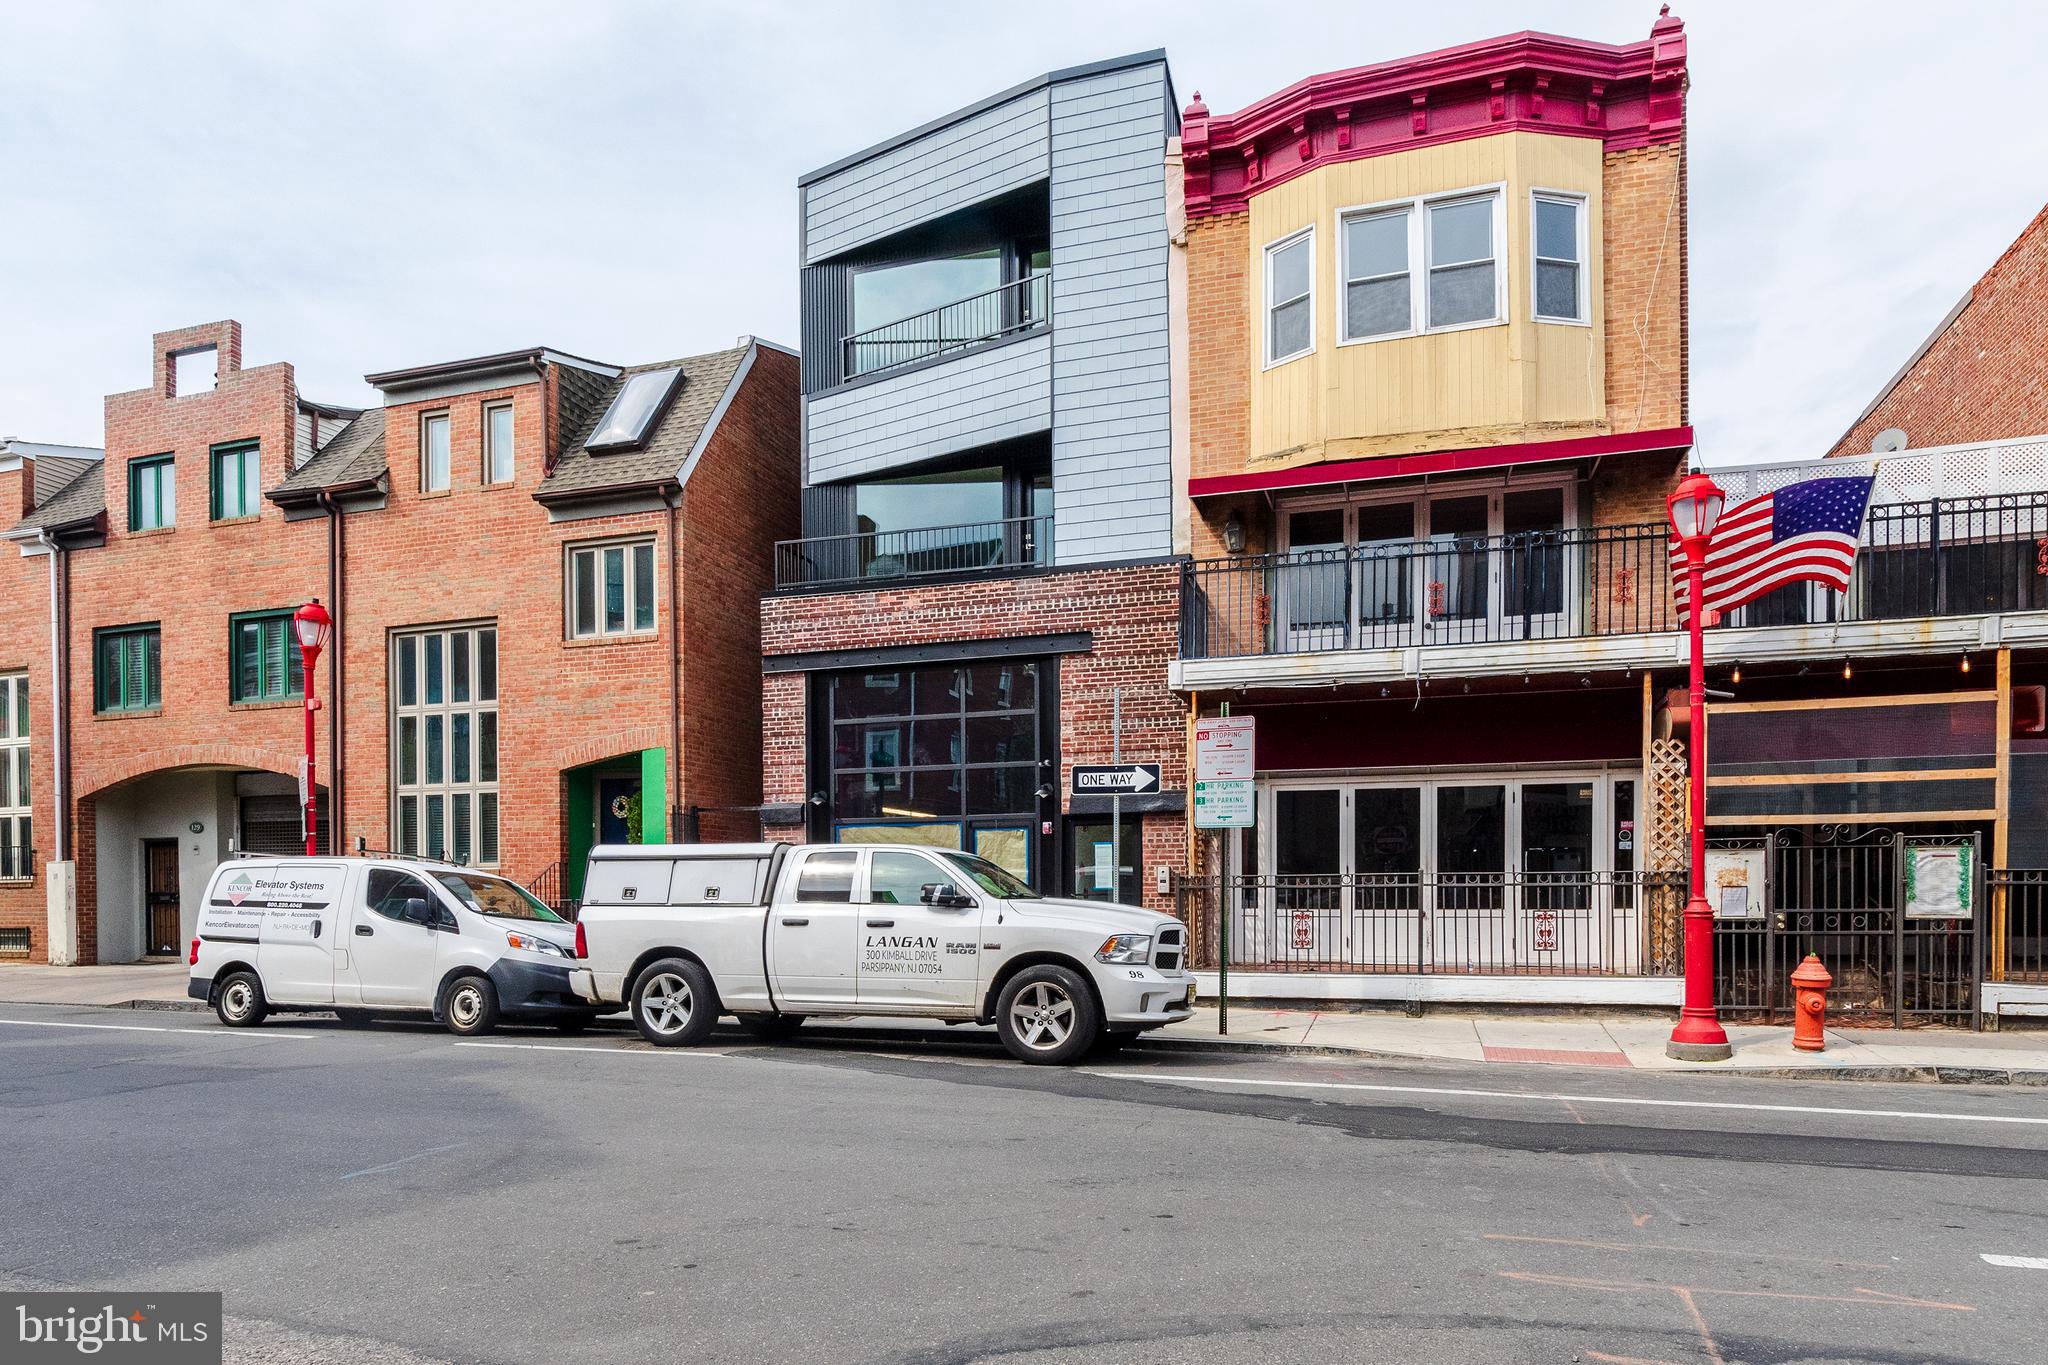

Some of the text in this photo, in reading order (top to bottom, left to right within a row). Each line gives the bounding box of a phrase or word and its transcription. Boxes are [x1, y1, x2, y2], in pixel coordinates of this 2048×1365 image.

[1212, 731, 1243, 739] STOPPING
[1081, 773, 1134, 786] ONE WAY
[255, 879, 325, 891] Elevator Systems
[291, 911, 321, 919] Accessibility
[205, 921, 260, 929] KencorElevator.com
[866, 936, 938, 948] LANGAN
[866, 950, 937, 962] 300 KIMBALL DRIVE
[861, 962, 943, 974] PARSIPPANY, NJ 07054
[1128, 970, 1145, 979] 98
